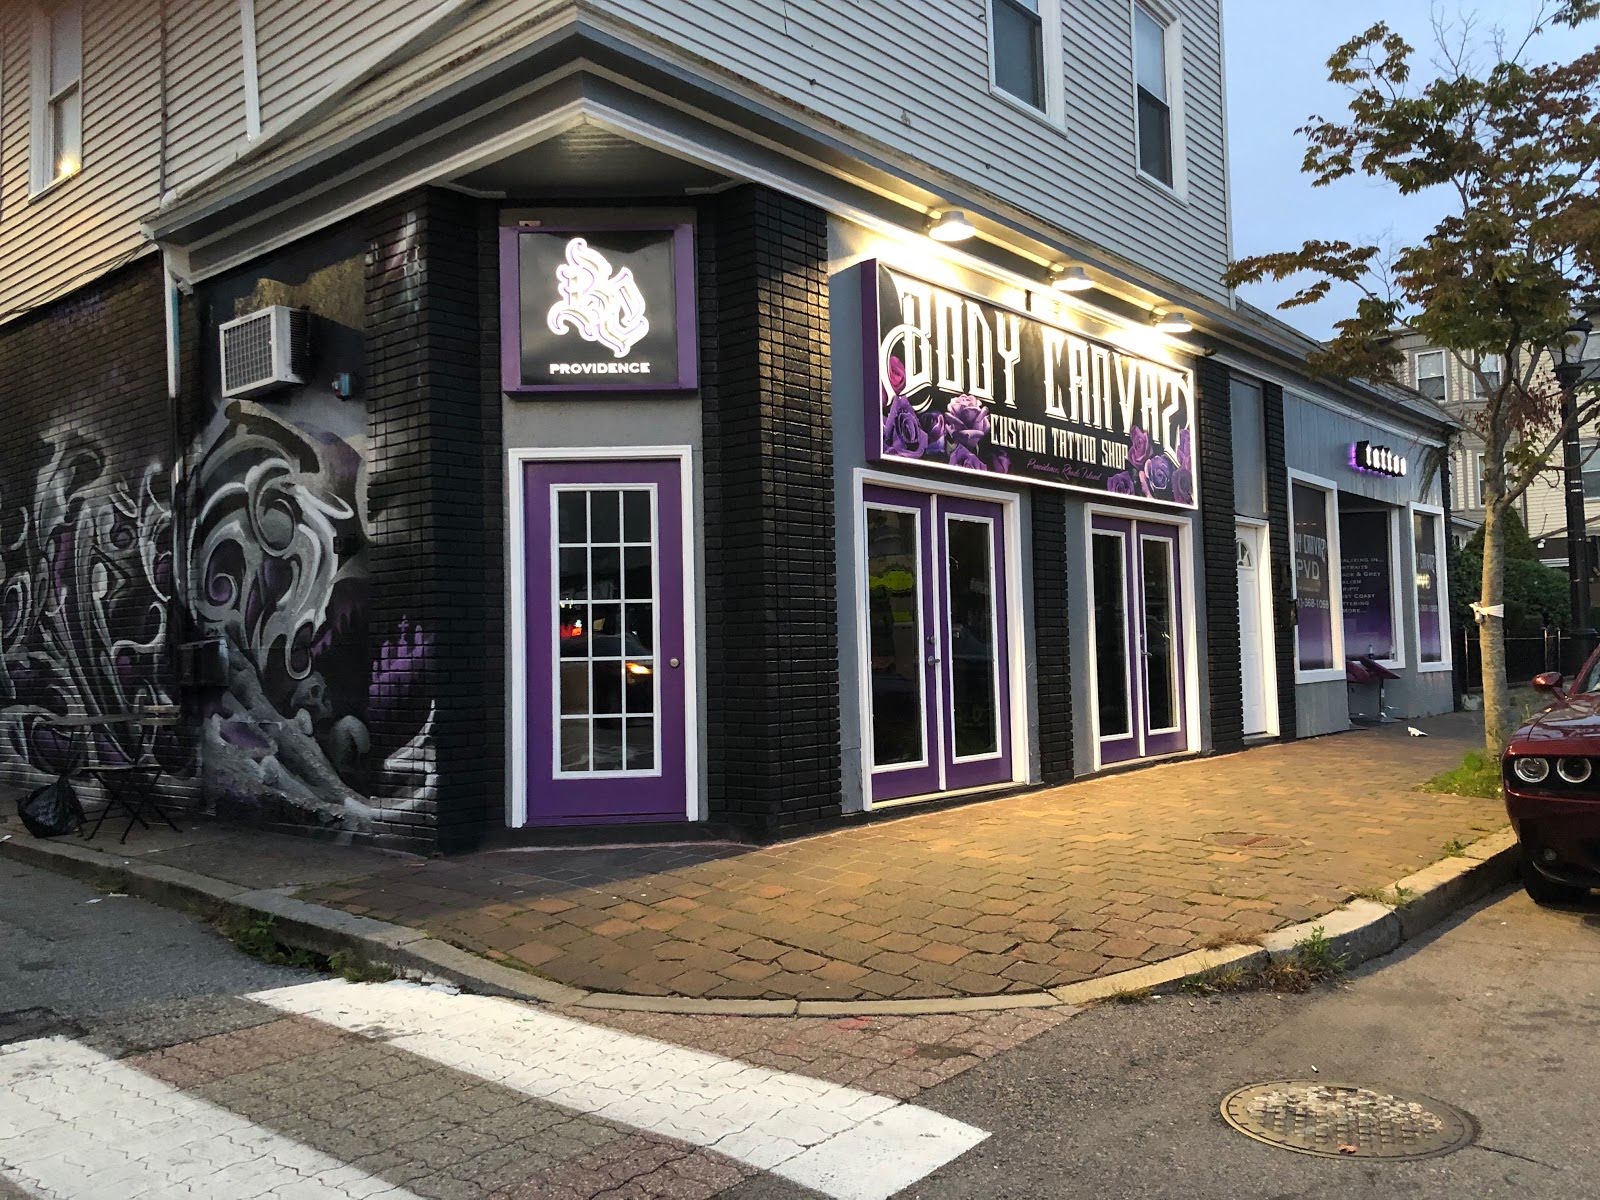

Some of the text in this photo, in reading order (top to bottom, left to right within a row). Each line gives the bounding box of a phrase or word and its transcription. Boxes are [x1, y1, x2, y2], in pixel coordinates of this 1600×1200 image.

[549, 362, 651, 375] PROVIDENCE
[880, 285, 1193, 468] BODY CANVAS
[990, 413, 1129, 470] CUSTOM TATTOO SHOP
[1296, 559, 1320, 580] PVD
